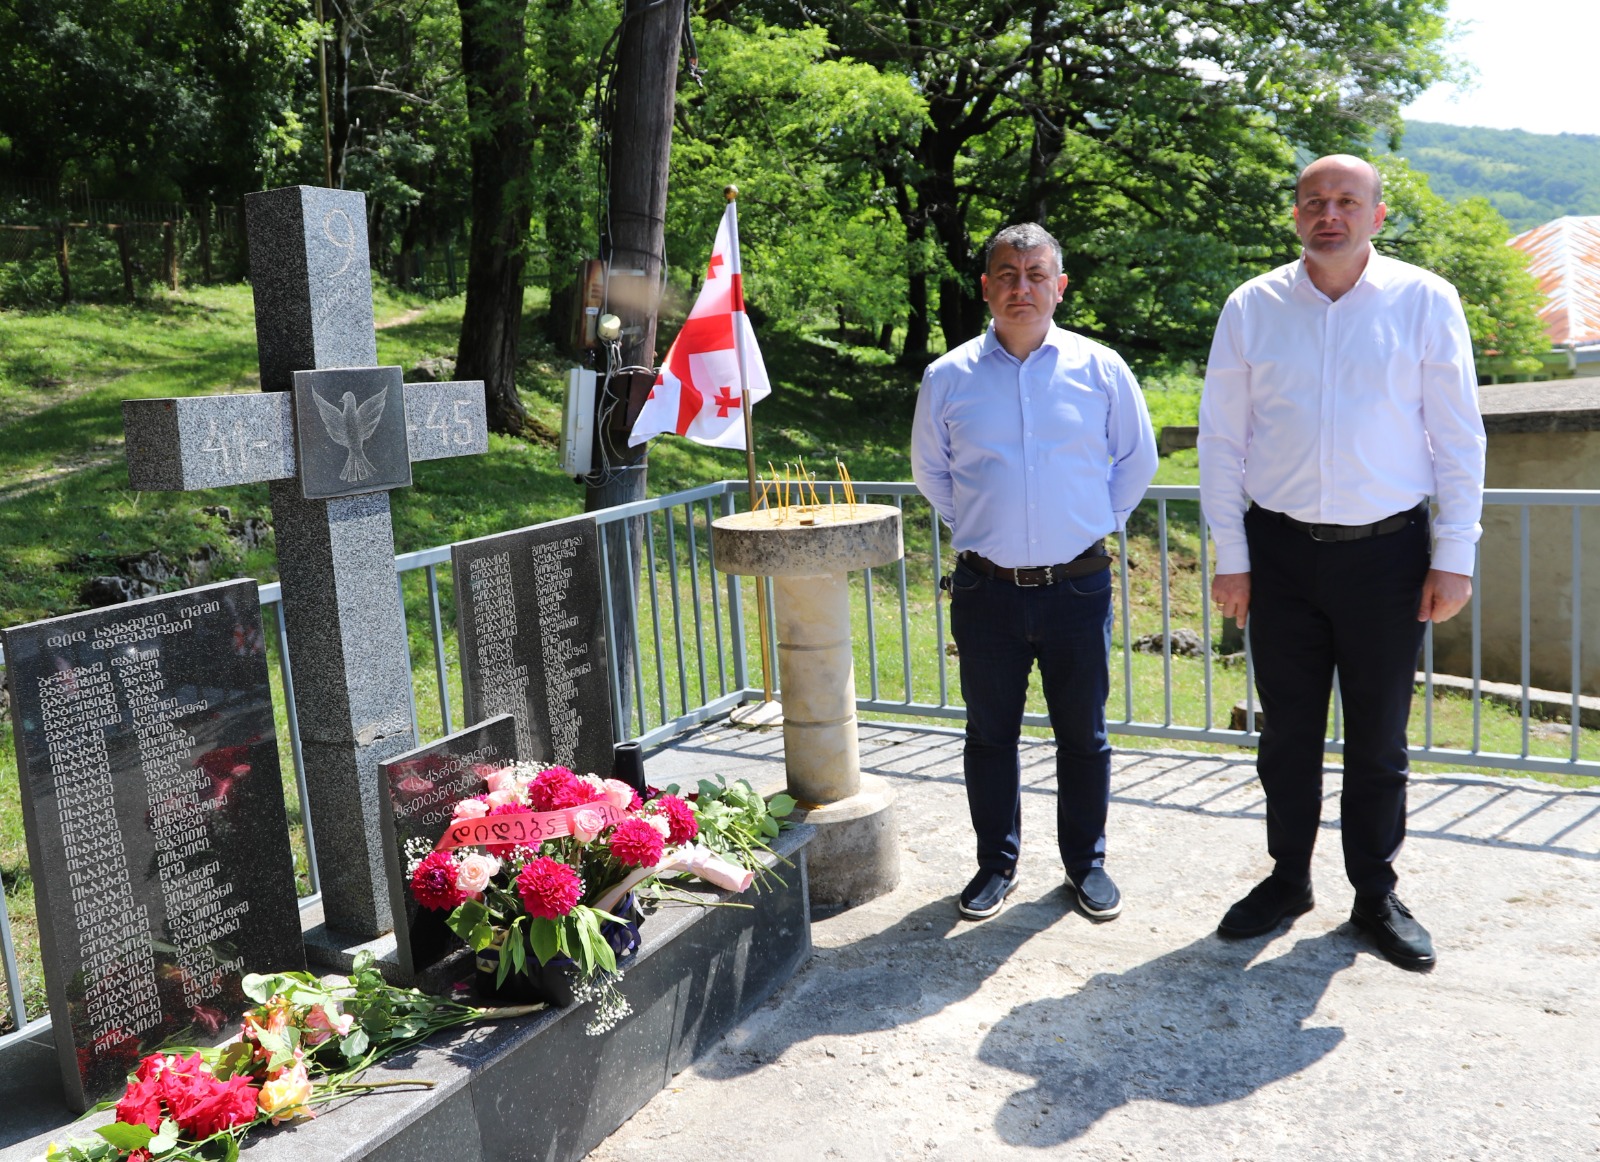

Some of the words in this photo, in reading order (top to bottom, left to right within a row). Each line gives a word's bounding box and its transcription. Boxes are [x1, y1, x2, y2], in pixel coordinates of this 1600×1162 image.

[323, 208, 355, 278] 9
[46, 630, 86, 649] დიდ
[93, 611, 166, 640] სამამულო
[179, 600, 219, 619] ომში
[91, 618, 191, 652] დაღუპულები
[110, 647, 159, 669] დავითი
[38, 670, 110, 699] გაბრიჭიძე
[40, 681, 114, 711] გაბრიჭიძე
[122, 668, 161, 688] შალვა
[41, 691, 115, 722] გაბრიჭიძე
[125, 679, 163, 699] აკაკი
[132, 696, 177, 718] იულონი
[43, 703, 118, 732] გაბრიჭიძე
[48, 727, 104, 753] ისაკაძე
[132, 698, 208, 730] ალექსანდრე
[49, 739, 106, 765] ისაკაძე
[135, 719, 174, 741] შოთა
[51, 749, 108, 776] ისაკაძე
[138, 726, 186, 751] მირონა
[53, 760, 109, 788] ისაკაძე
[140, 734, 195, 761] ამბროსი
[55, 771, 111, 799] ისაკაძე
[141, 747, 190, 772] მიხეილი
[57, 782, 113, 810] ისაკაძე
[144, 761, 180, 783] შალვა
[58, 793, 114, 823] ისაკაძე
[60, 806, 115, 835] ისაკაძე
[147, 775, 210, 806] ნიკოლოზი
[62, 817, 118, 847] ისაკაძე
[149, 790, 199, 818] მიხეილი
[64, 828, 121, 859] ისაკაძე
[149, 793, 227, 830] კონსტანტინე
[66, 839, 124, 872] ისაკაძე
[153, 811, 203, 841] უშანგი
[452, 817, 557, 844] დიდება
[69, 853, 126, 887] ისაკაძე
[155, 823, 206, 854] დავითი
[71, 867, 129, 902] ისაკაძე
[157, 835, 209, 867] მიხეილი
[161, 858, 219, 895] ვარდენი
[74, 880, 131, 915] ისაკაძე
[159, 859, 185, 881] ნოე
[78, 902, 147, 945] რობაქიძე
[164, 875, 213, 907] მიხეილი
[79, 915, 149, 958] რობაქიძე
[80, 928, 152, 973] რობაქიძე
[168, 898, 221, 932] დავითი
[83, 942, 153, 987] რობაქიძე
[172, 898, 248, 945] ალექსანდრე
[84, 954, 154, 1001] რობაქიძე
[86, 970, 155, 1014] რობაქიძე
[89, 981, 157, 1027] რობაქიძე
[91, 994, 160, 1042] რობაქიძე
[94, 1008, 162, 1056] რობაქიძე
